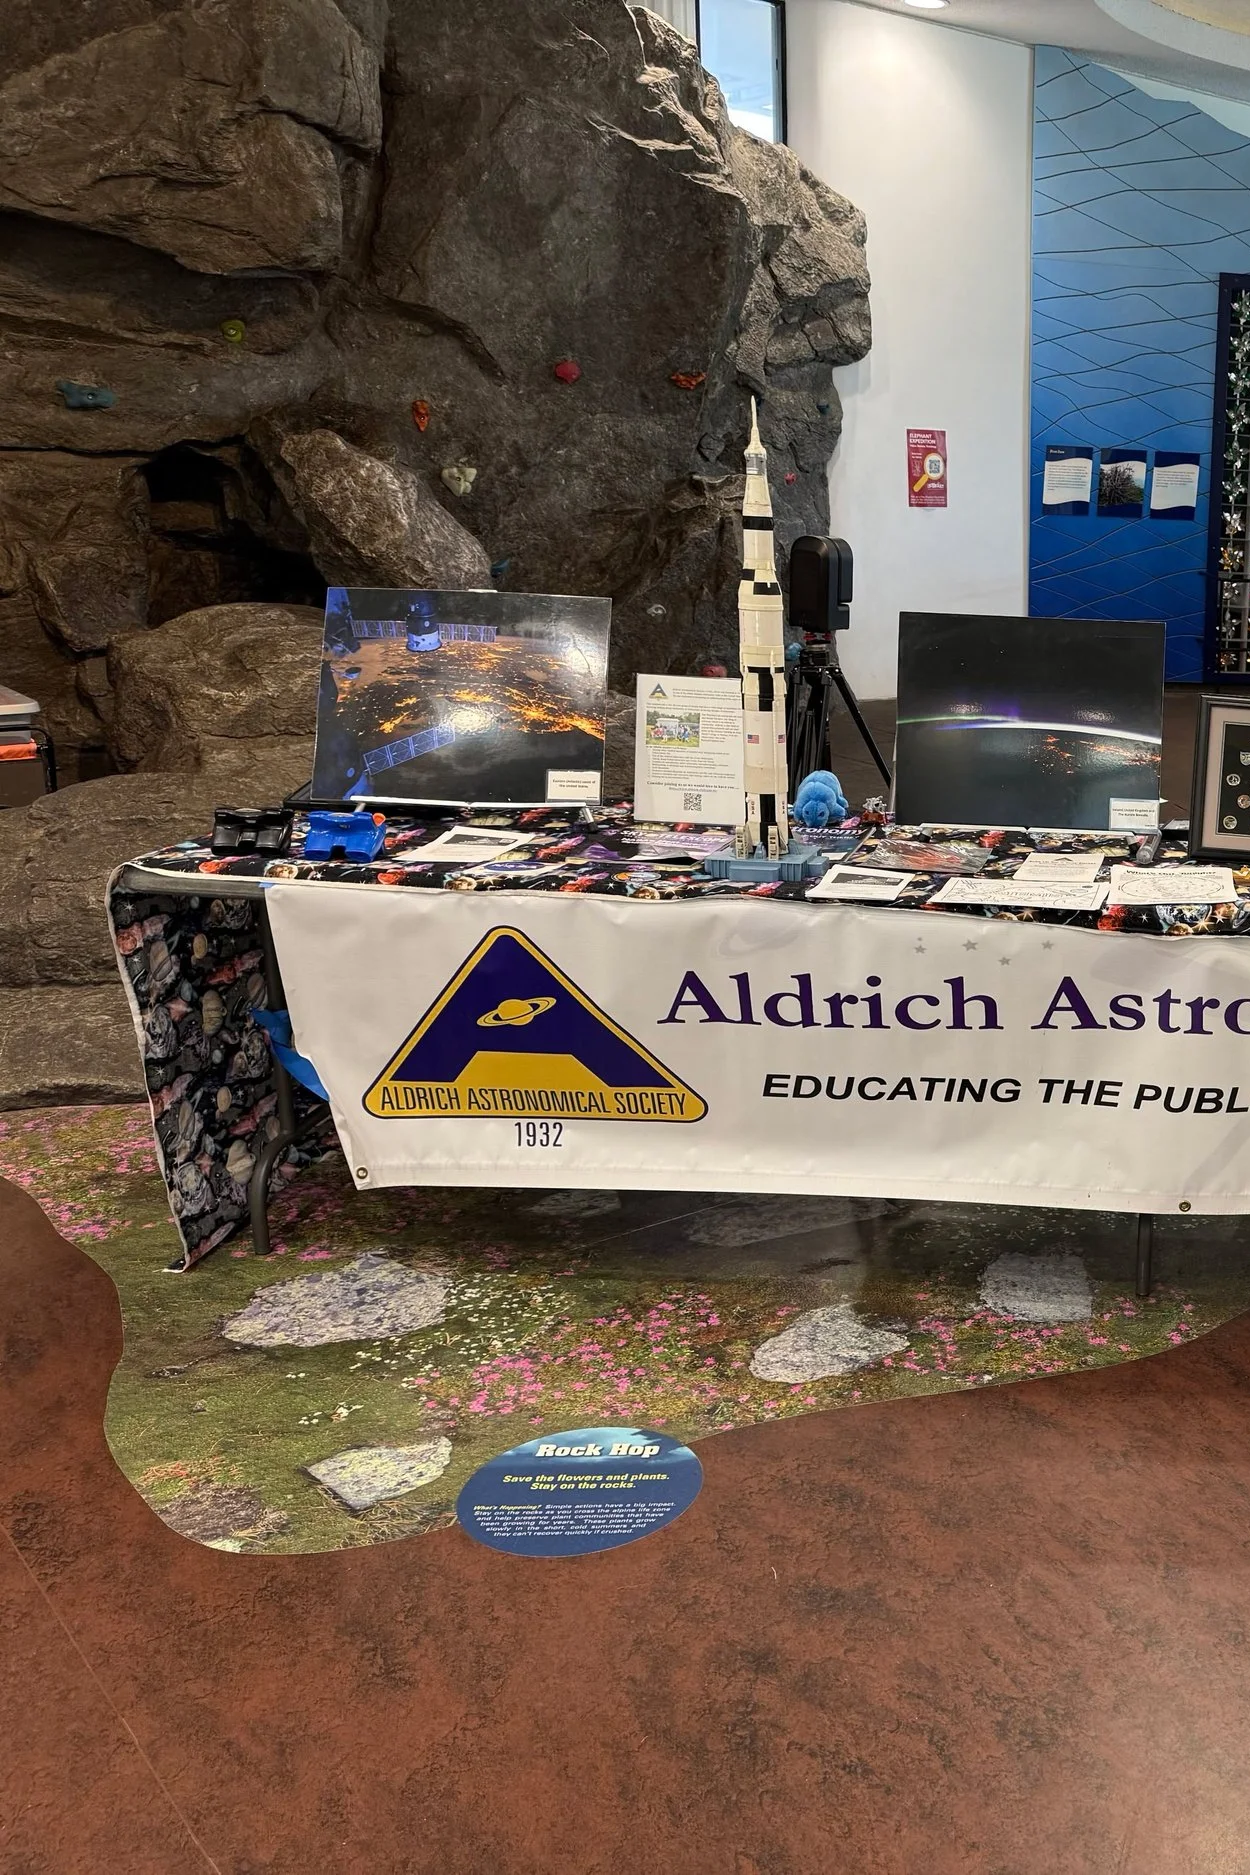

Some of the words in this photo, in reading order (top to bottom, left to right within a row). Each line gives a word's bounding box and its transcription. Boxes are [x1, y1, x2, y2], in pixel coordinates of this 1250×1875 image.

[657, 971, 1004, 1031] Aldrich
[381, 1086, 461, 1111] ALDRICH
[468, 1087, 611, 1113] ASTRONOMICAL
[615, 1091, 686, 1116] SOCIETY
[762, 1073, 1021, 1104] EDUCATING
[1038, 1077, 1123, 1107] THE
[514, 1121, 563, 1147] 1932
[535, 1443, 603, 1457] Rock
[608, 1443, 660, 1459] Hop
[502, 1474, 532, 1483] Save
[535, 1474, 554, 1483] the
[557, 1473, 603, 1482] flowers
[605, 1473, 627, 1481] and
[630, 1472, 670, 1482] plants.
[530, 1482, 557, 1491] Stay
[577, 1482, 597, 1490] the
[600, 1481, 637, 1489] rocks.
